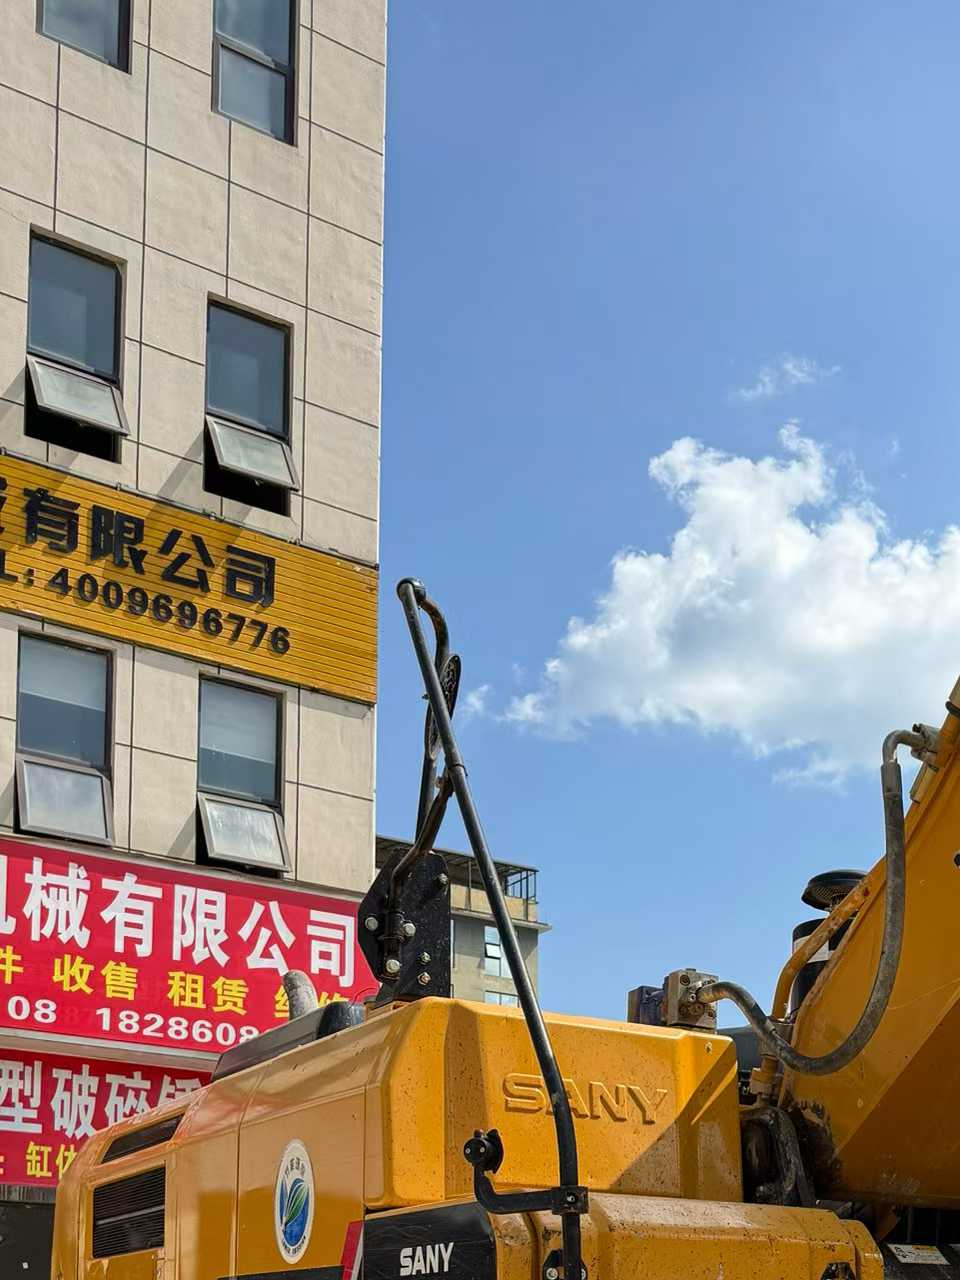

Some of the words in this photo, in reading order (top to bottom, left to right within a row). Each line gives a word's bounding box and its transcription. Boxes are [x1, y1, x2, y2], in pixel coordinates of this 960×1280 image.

[0, 476, 276, 606] 有限公司
[48, 567, 291, 655] 4009696776
[52, 953, 138, 1001] 收售
[167, 970, 249, 1015] 租赁
[503, 1073, 667, 1125] SANY
[400, 1242, 454, 1276] SANY
